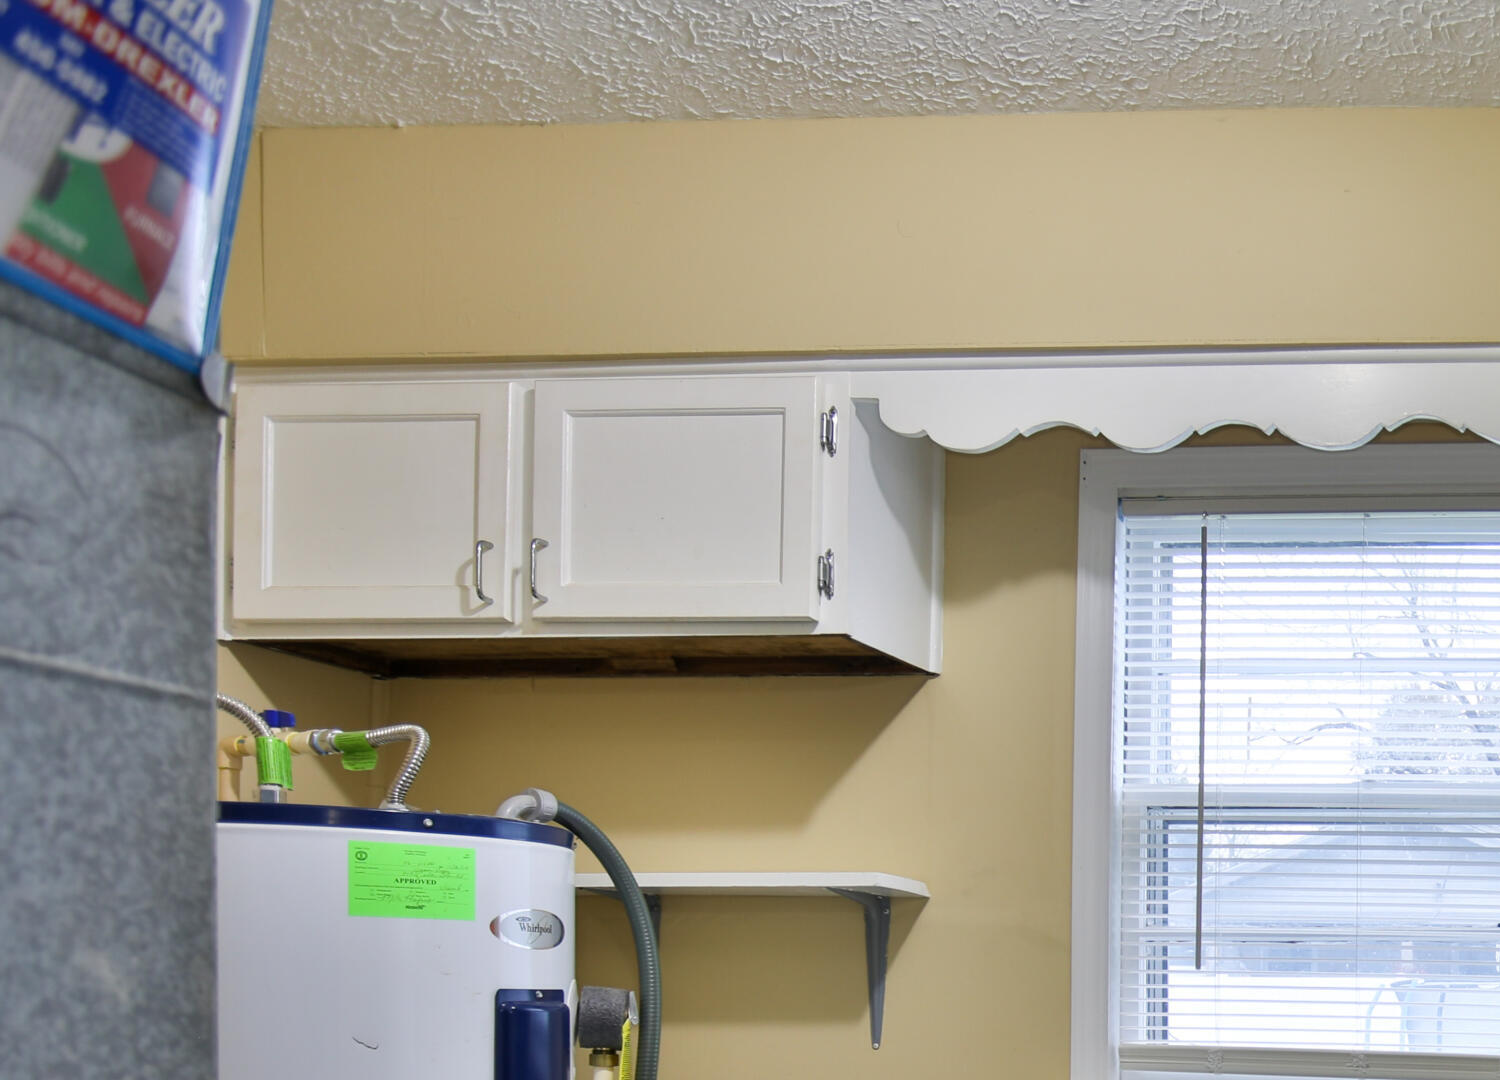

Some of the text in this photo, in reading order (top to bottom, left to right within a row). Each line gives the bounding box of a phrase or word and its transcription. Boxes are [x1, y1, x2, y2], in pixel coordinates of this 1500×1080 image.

[134, 9, 228, 101] ELECTRIC
[393, 877, 437, 886] APPROVED
[519, 923, 552, 936] Whirlpool
